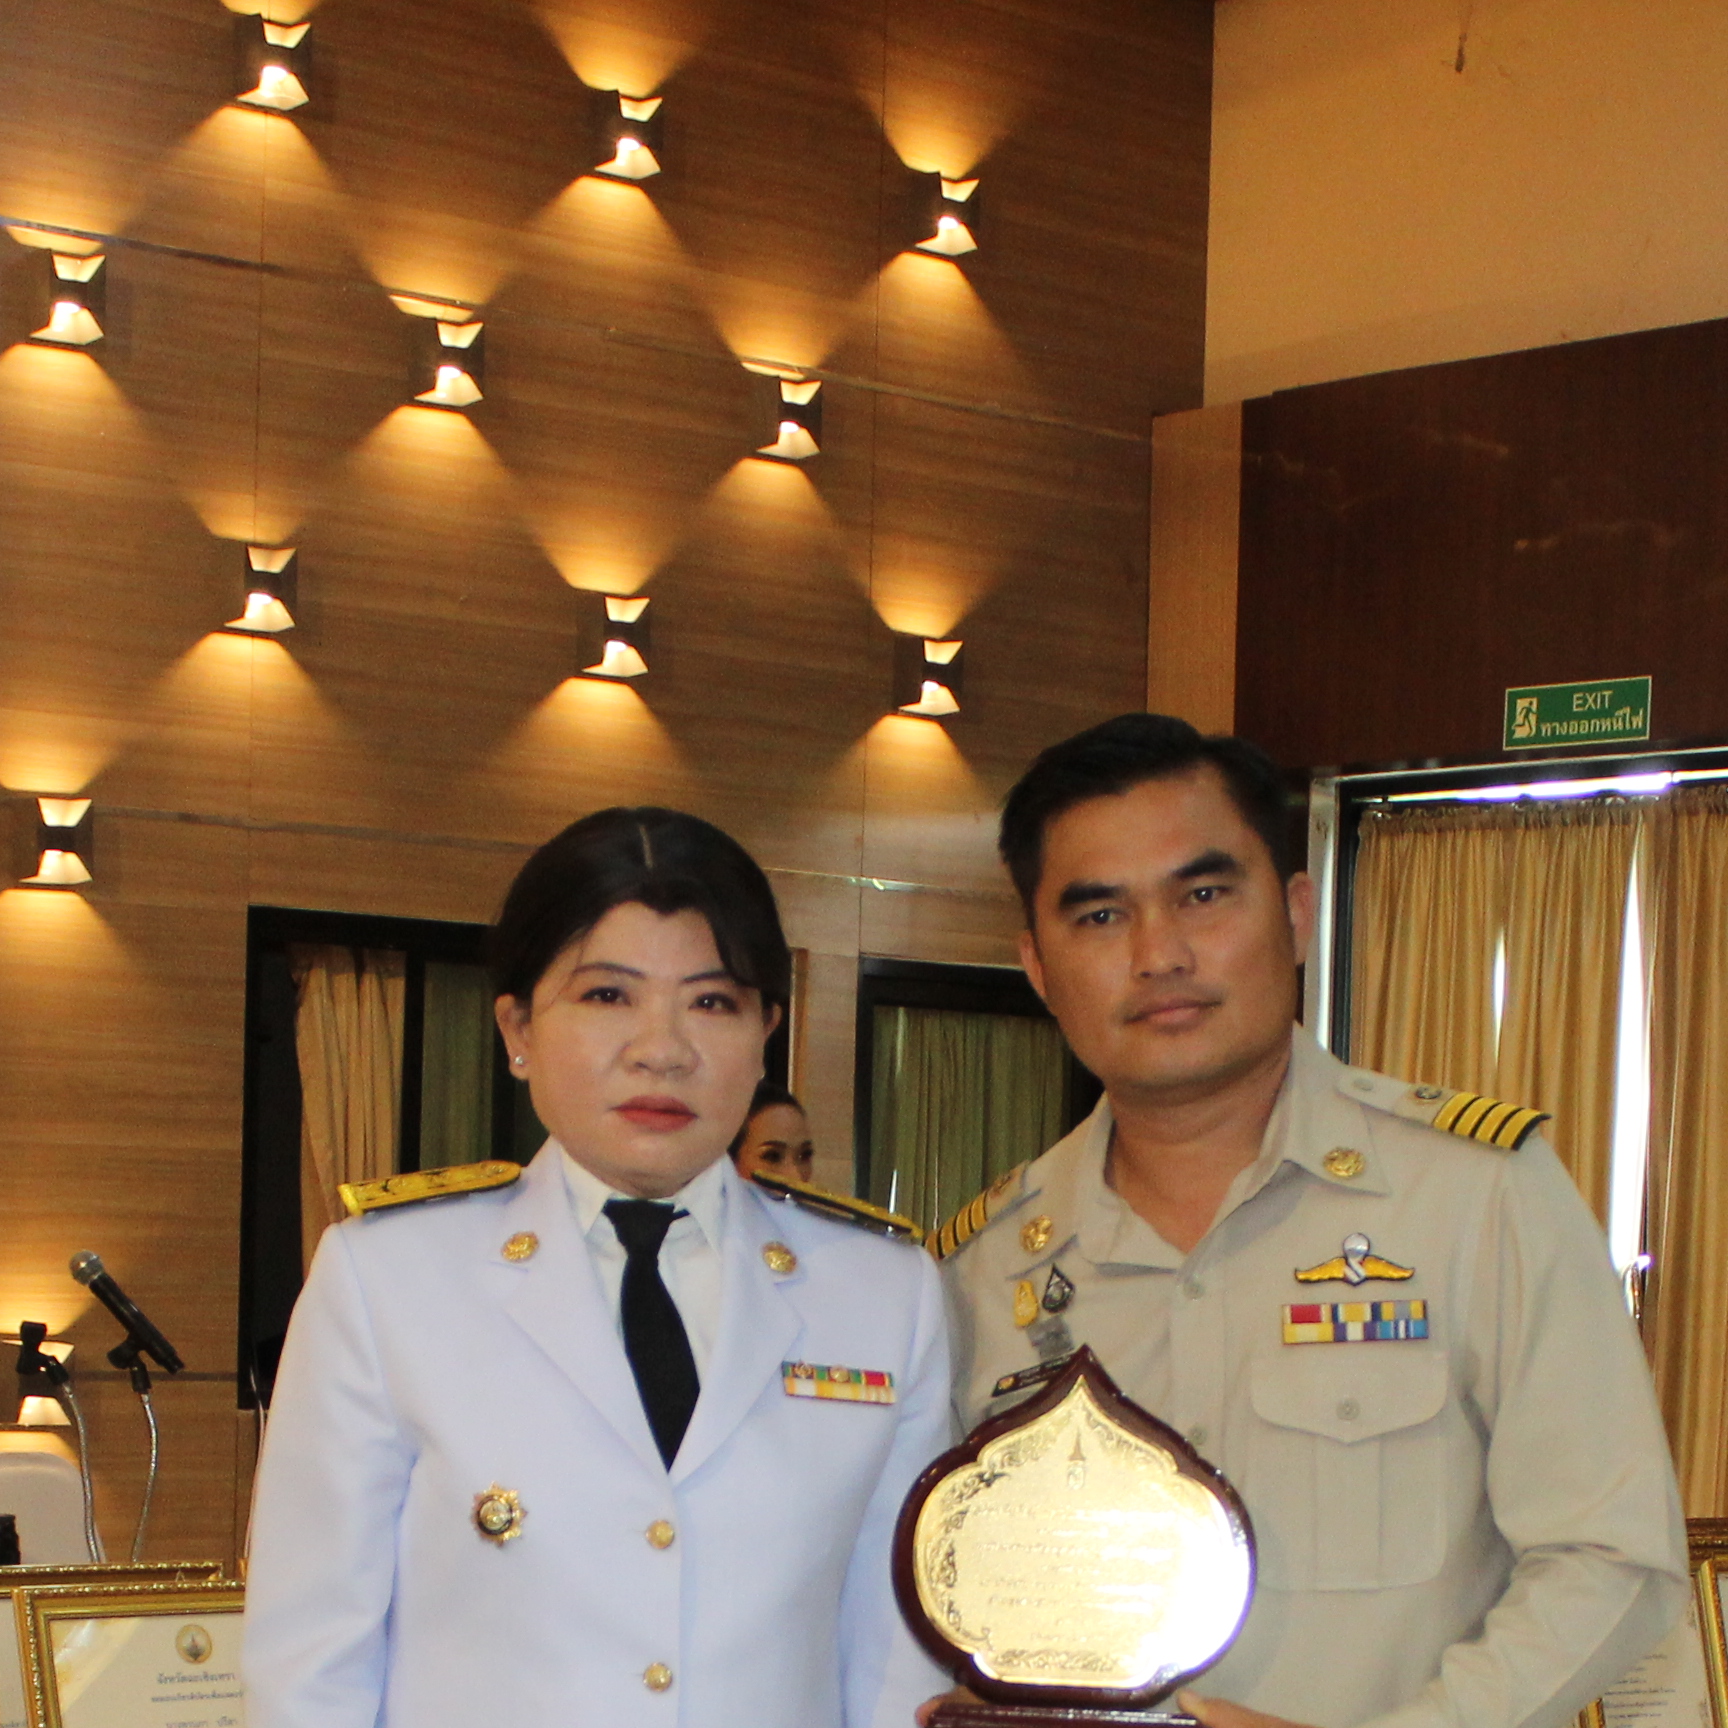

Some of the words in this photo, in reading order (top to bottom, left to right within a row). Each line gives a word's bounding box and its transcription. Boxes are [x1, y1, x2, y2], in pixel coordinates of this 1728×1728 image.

[1572, 690, 1614, 712] EXIT
[1540, 706, 1645, 737] ทางออกหนีไฟ
